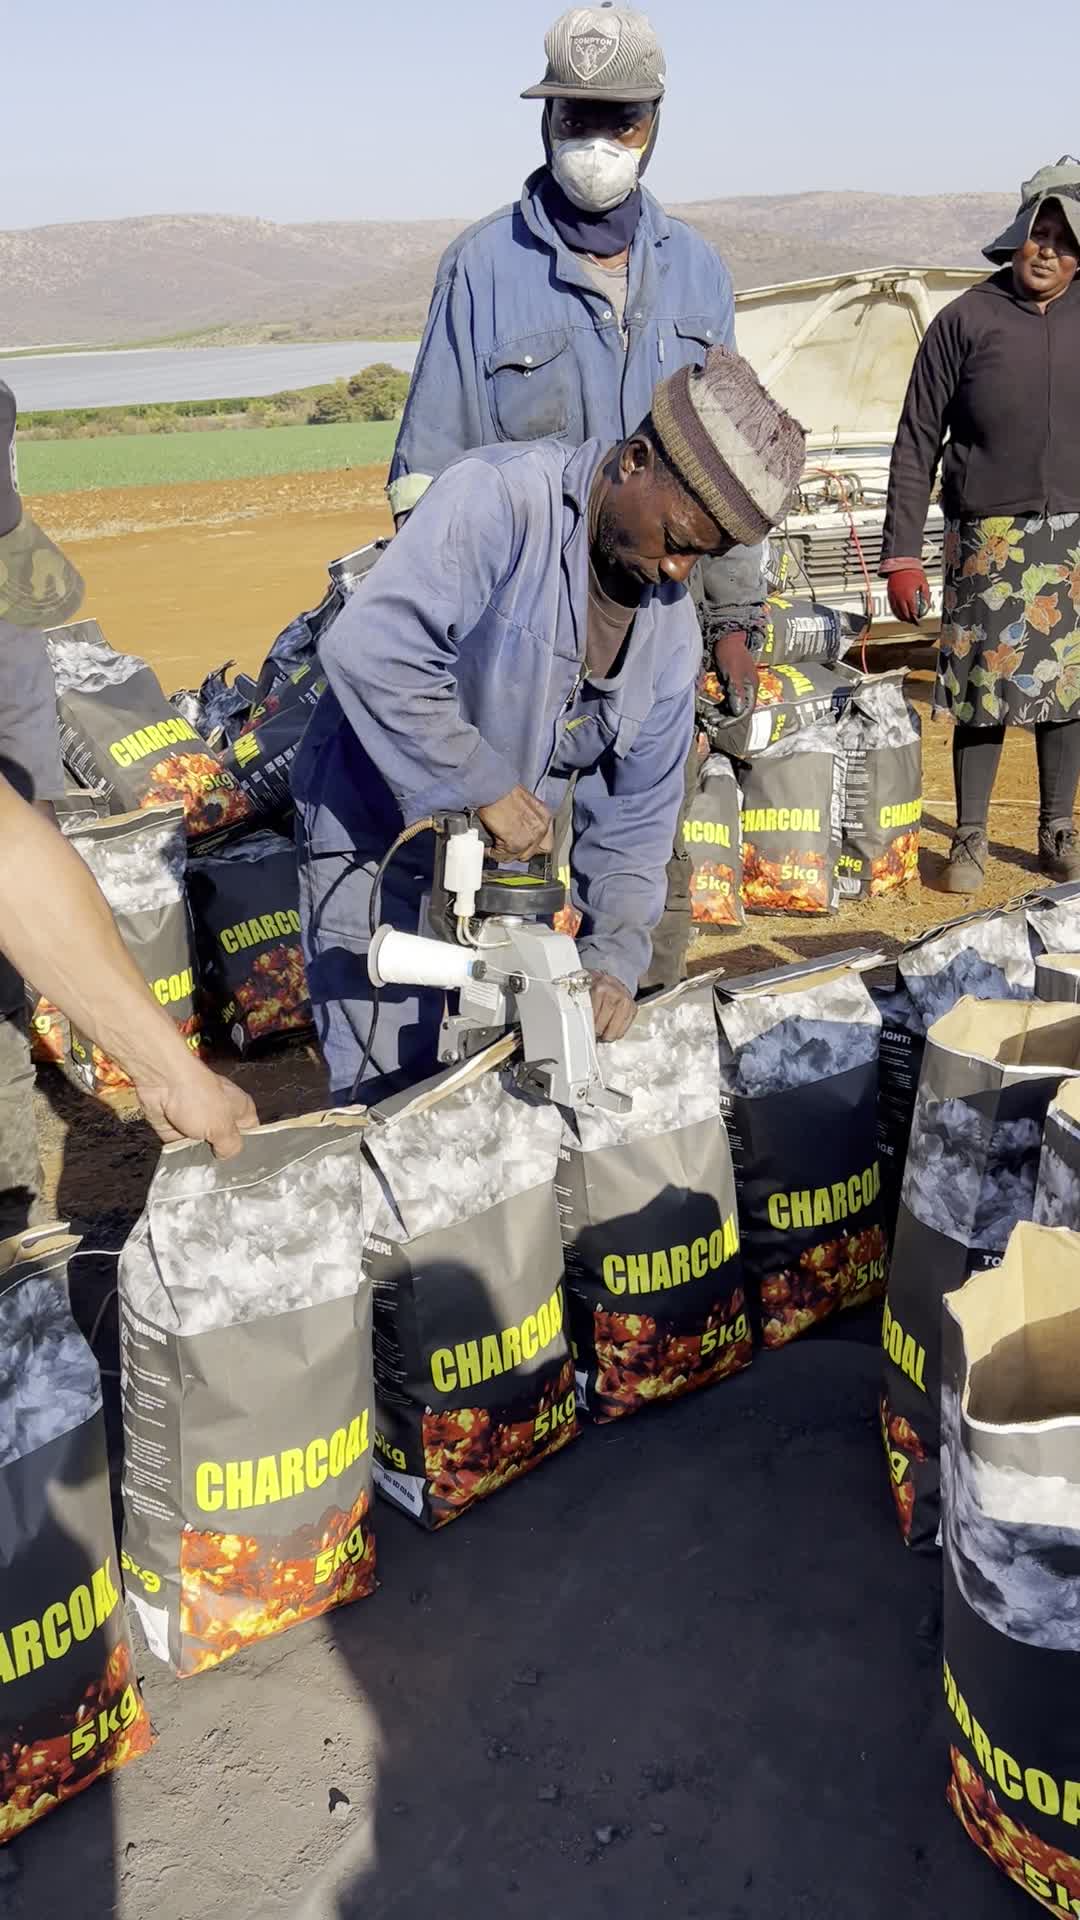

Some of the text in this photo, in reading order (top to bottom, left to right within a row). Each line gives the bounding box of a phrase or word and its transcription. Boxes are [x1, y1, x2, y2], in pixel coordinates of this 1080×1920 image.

[201, 772, 235, 792] 5kg
[695, 875, 730, 897] 5kg
[780, 865, 818, 884] 5kg
[983, 1255, 1002, 1267] TO
[701, 1312, 747, 1356] 5kg
[533, 1390, 576, 1442] 5kg
[196, 1408, 369, 1512] CHARCOAL
[314, 1524, 365, 1585] 5kg
[72, 1683, 137, 1761] 5kg
